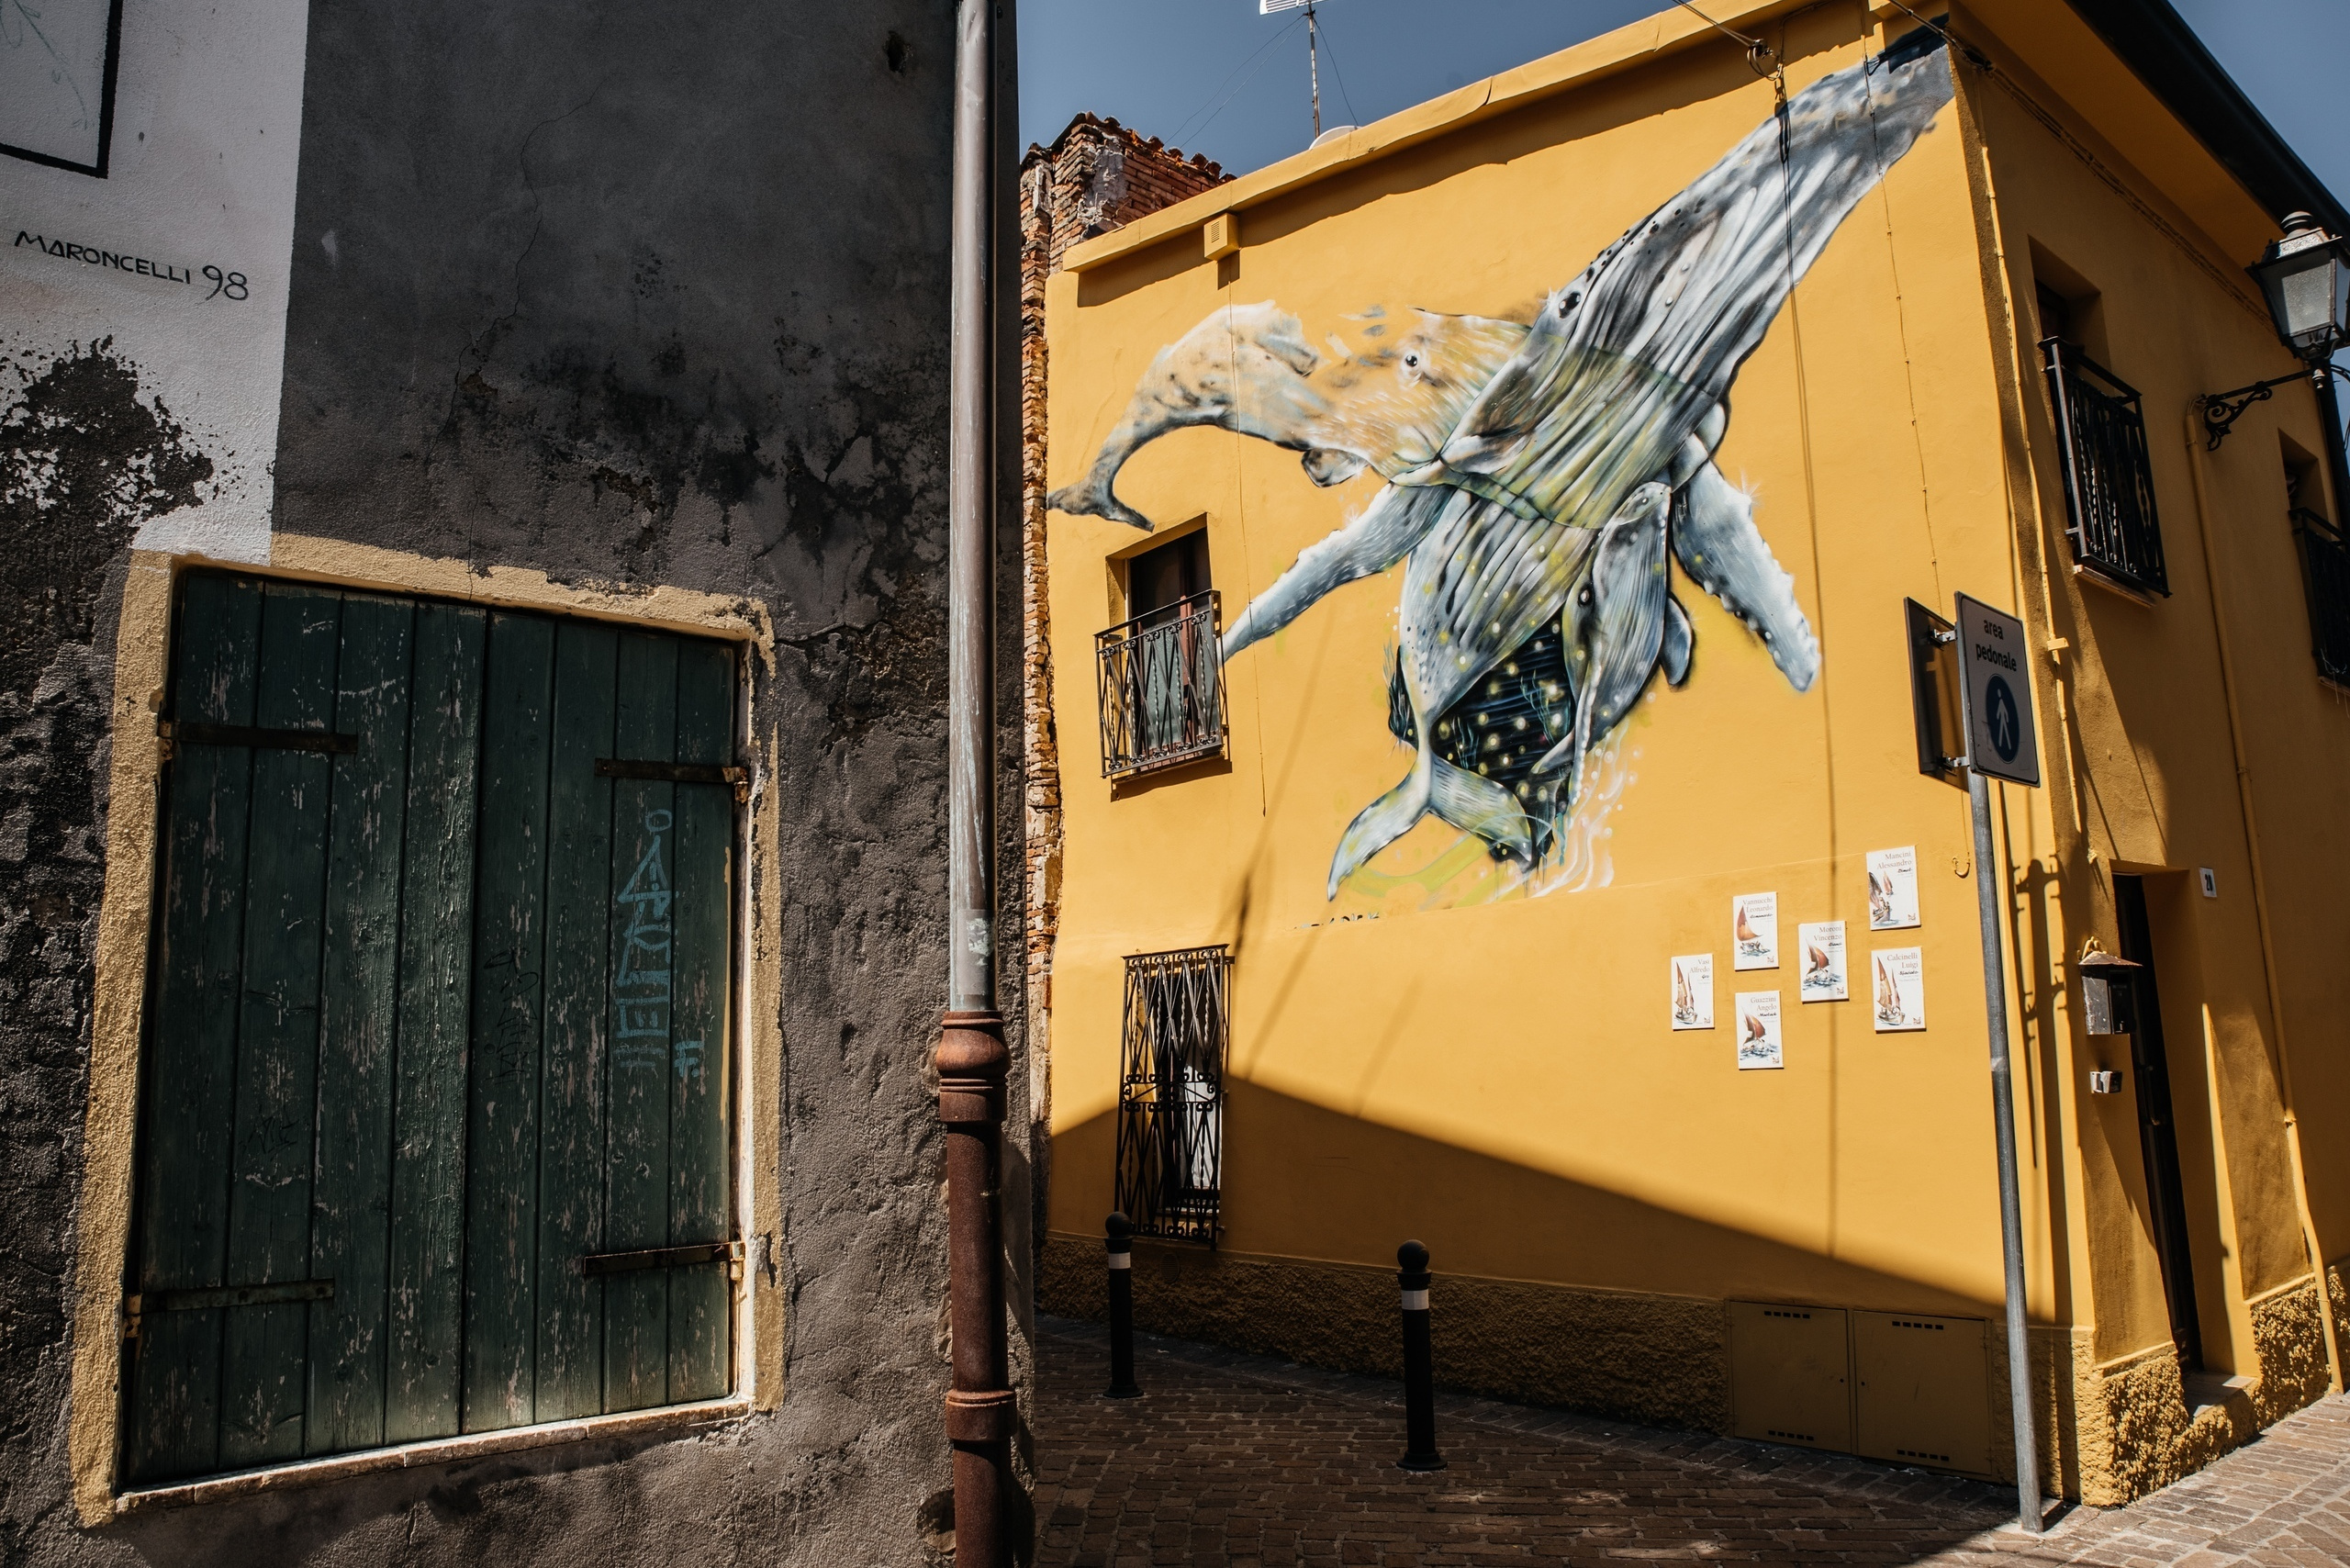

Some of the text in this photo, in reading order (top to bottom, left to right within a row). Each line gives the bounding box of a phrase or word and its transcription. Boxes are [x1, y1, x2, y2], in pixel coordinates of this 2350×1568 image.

[14, 230, 249, 302] MARONCELLI 98
[1984, 620, 2003, 640] area
[1975, 643, 2017, 672] pedonale
[1885, 851, 1910, 860] Mancini
[1877, 859, 1911, 869] Alessandro
[1742, 896, 1773, 905] Vannucchi
[1746, 904, 1774, 913] Leonardo
[1886, 953, 1918, 961] Calcinelli
[1901, 961, 1919, 970] Luigi
[1757, 1003, 1777, 1013] Angelo
